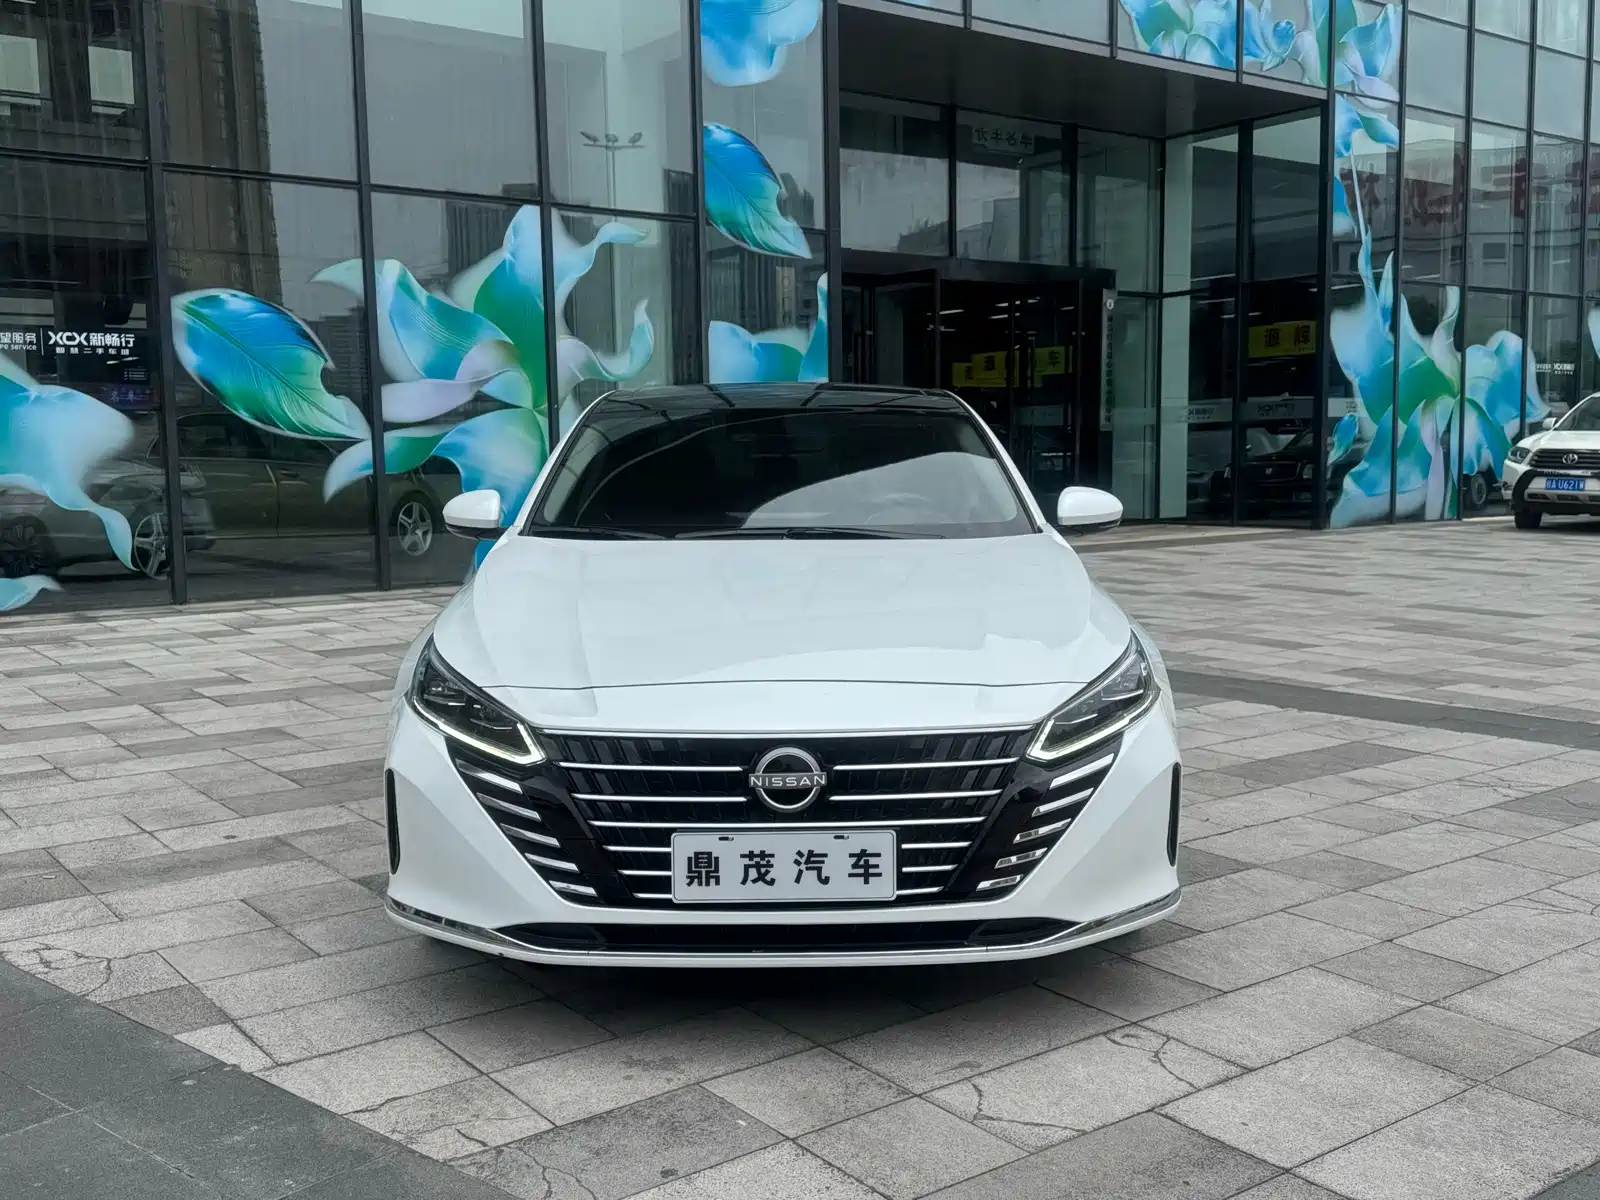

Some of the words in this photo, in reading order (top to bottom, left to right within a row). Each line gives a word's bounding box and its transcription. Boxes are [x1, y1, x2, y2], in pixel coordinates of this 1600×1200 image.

[750, 774, 826, 787] NISSAN
[686, 849, 883, 887] 鼎茂汽车
